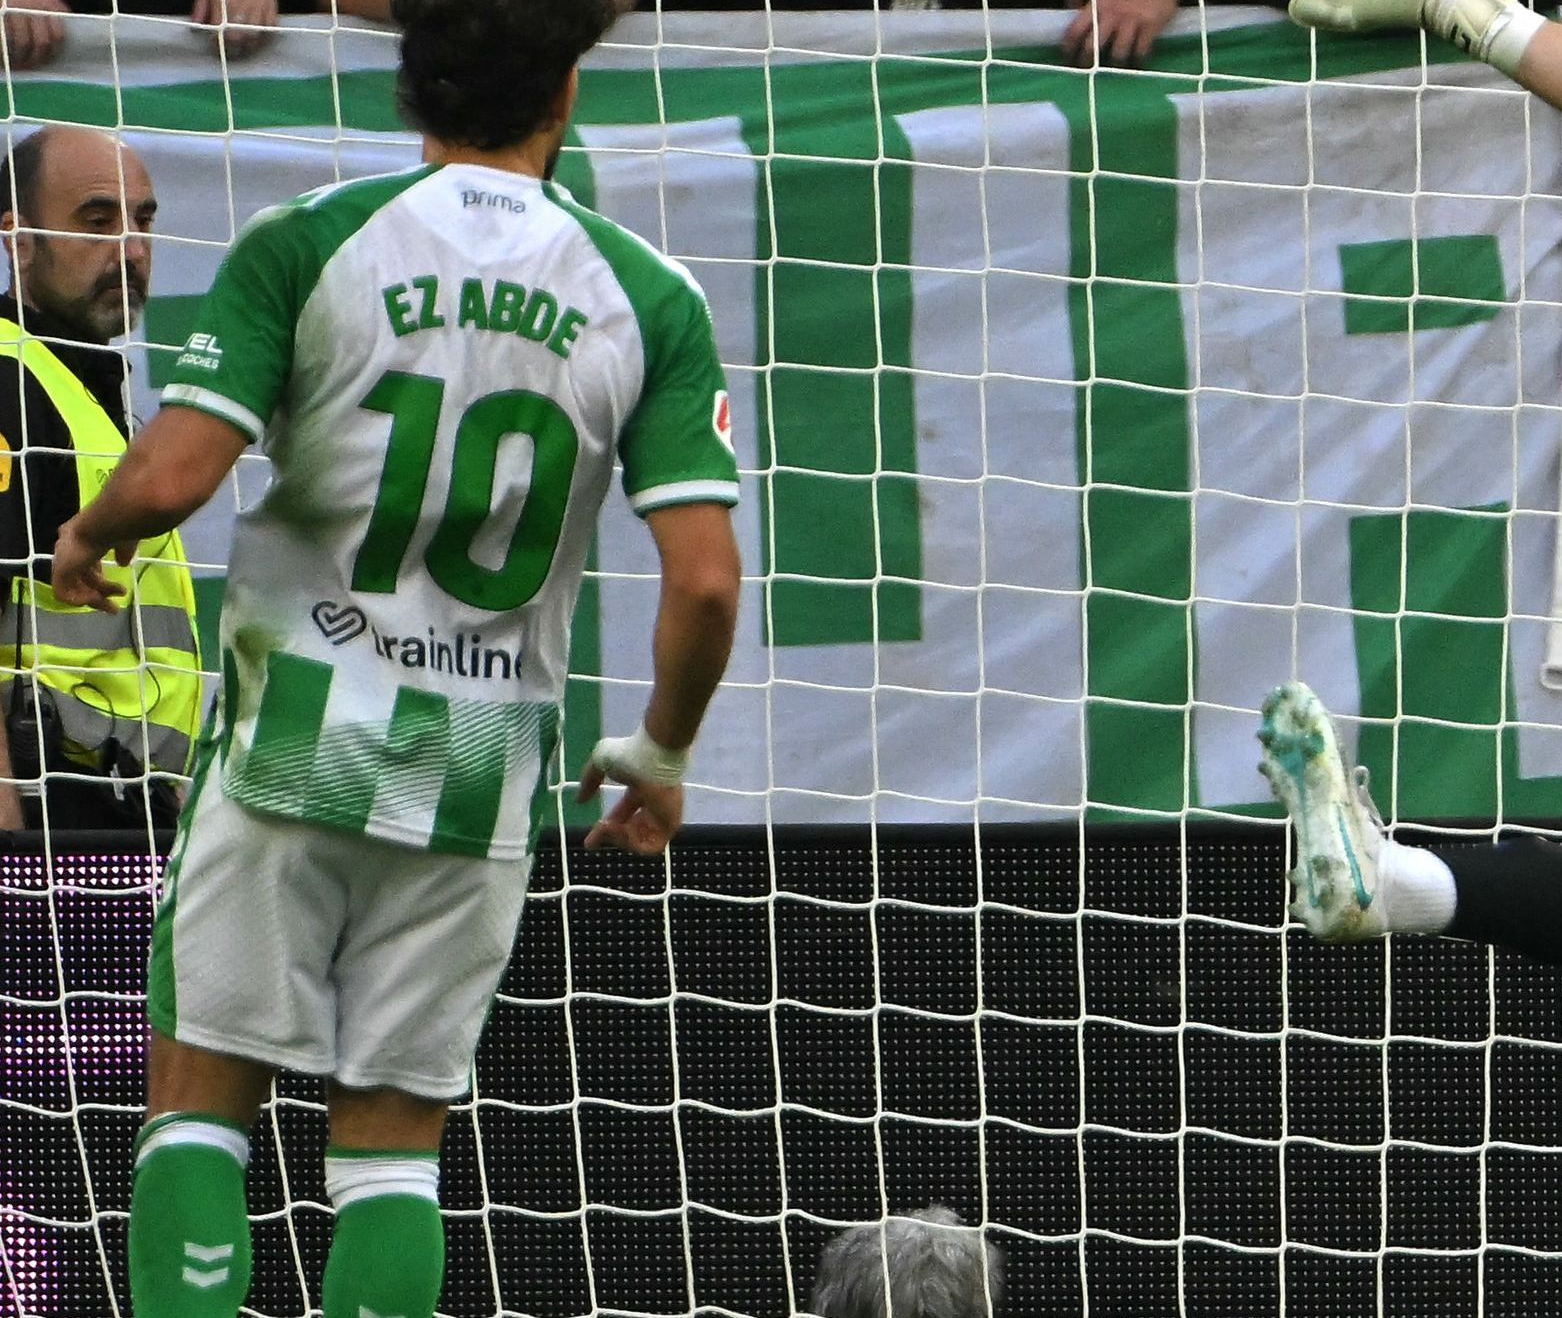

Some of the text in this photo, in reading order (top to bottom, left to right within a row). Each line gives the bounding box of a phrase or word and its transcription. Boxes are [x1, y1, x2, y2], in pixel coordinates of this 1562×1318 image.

[460, 189, 527, 214] prima
[382, 274, 589, 360] EZ ABDE
[350, 370, 578, 612] 10
